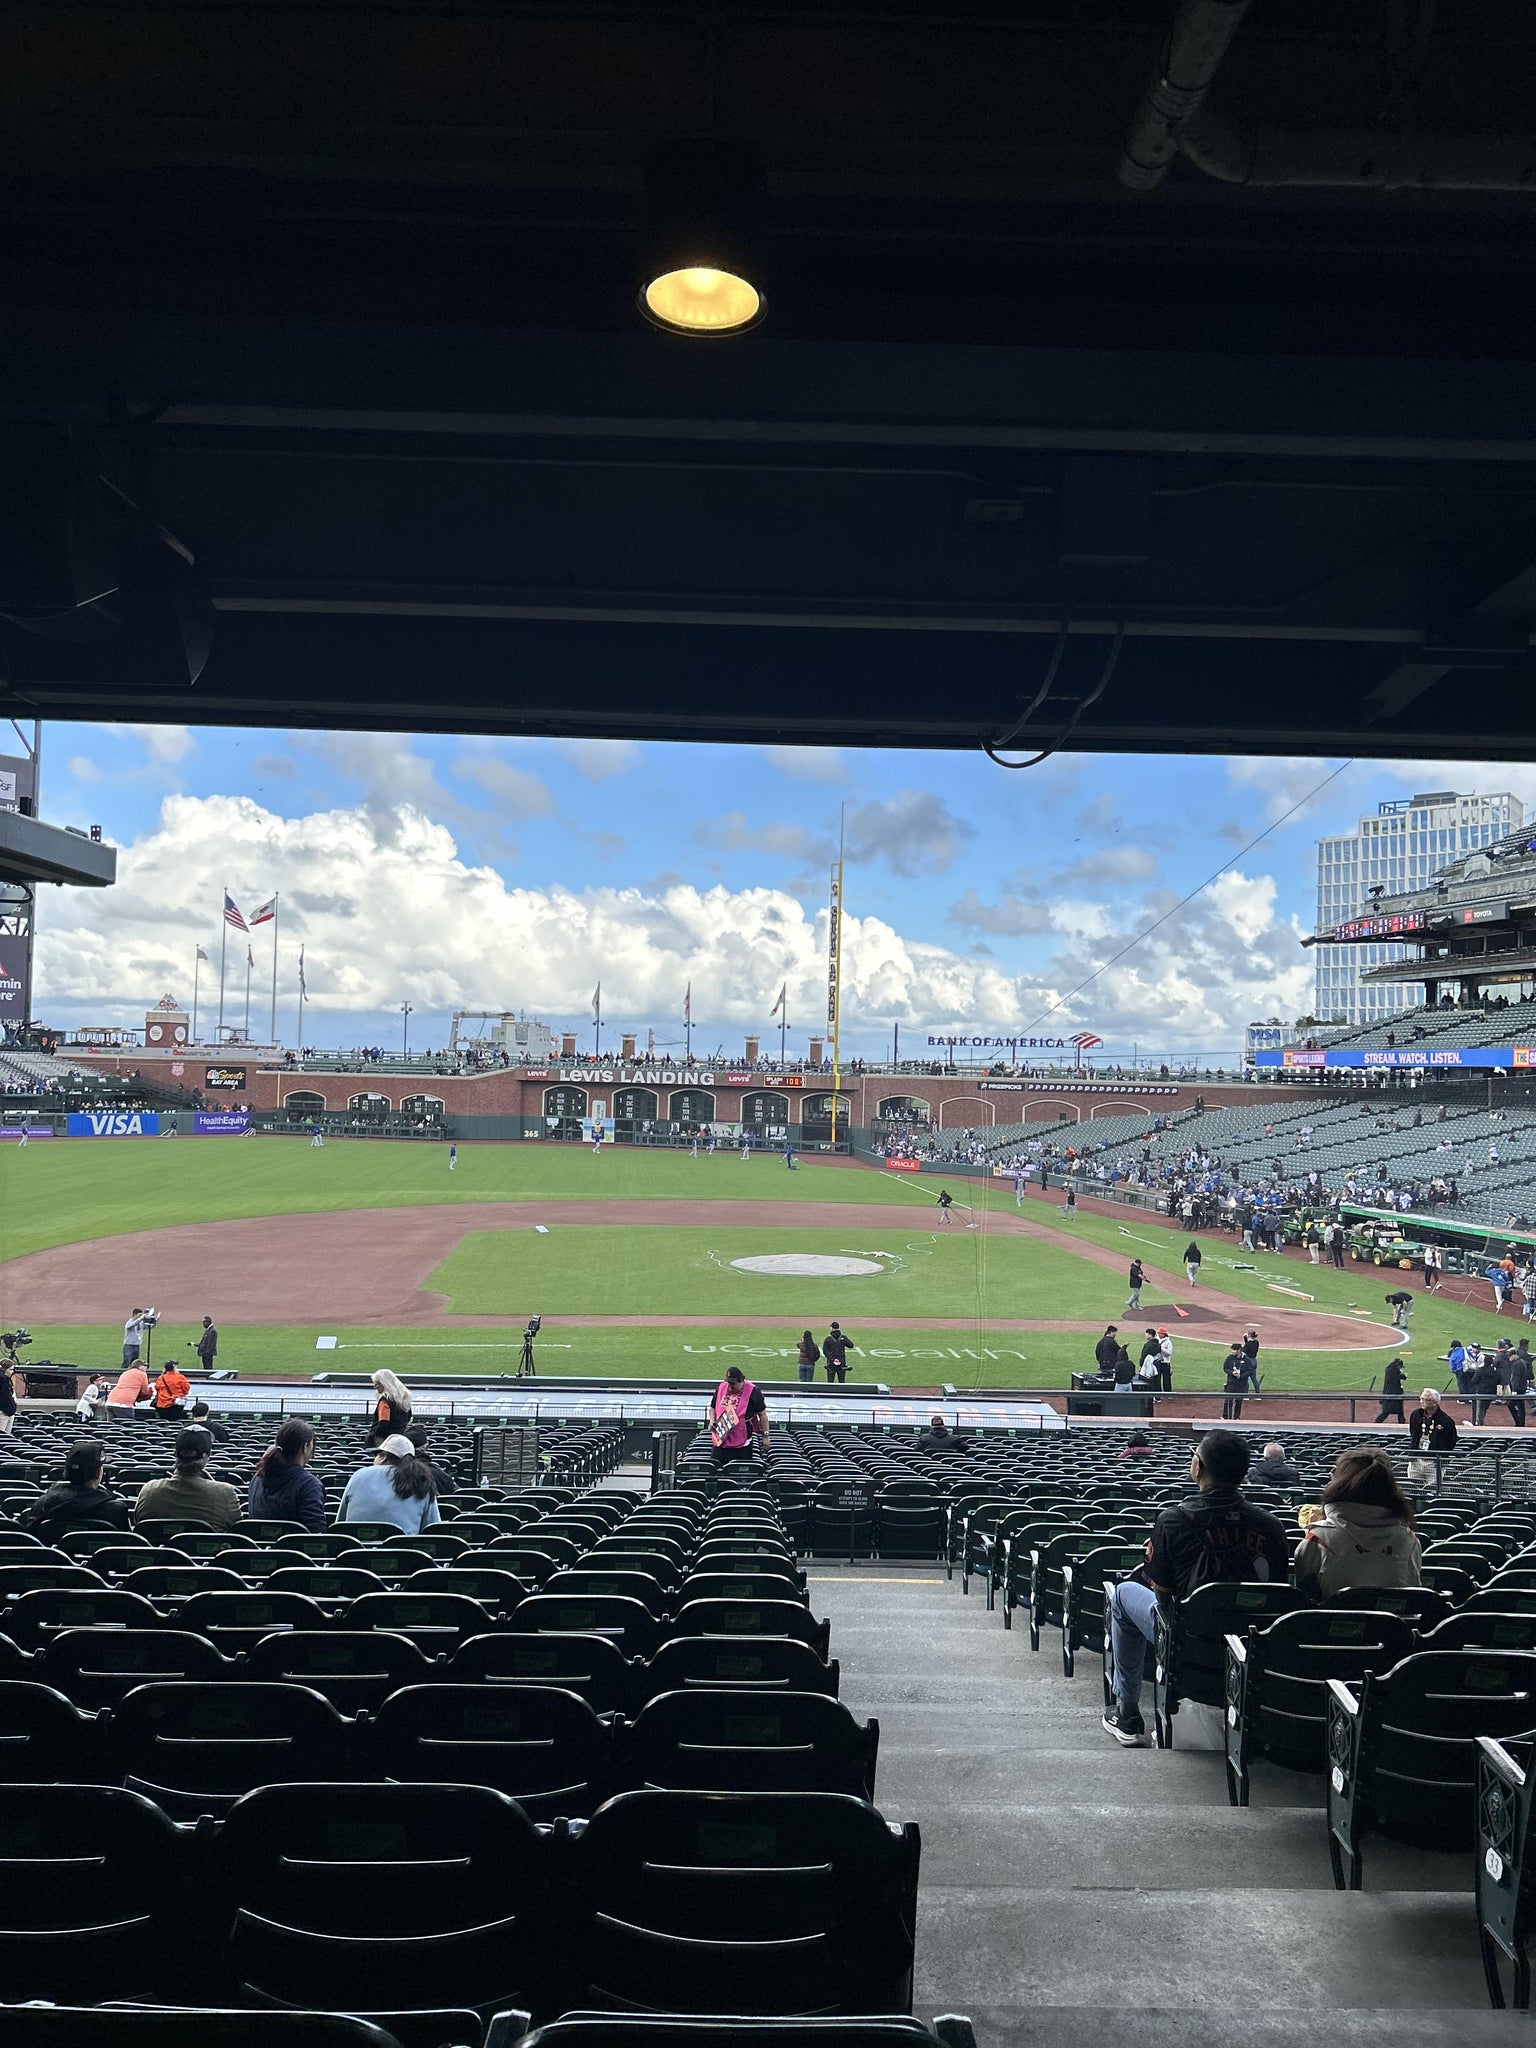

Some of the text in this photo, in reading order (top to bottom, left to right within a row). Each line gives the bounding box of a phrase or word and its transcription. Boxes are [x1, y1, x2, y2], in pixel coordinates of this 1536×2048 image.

[1473, 909, 1493, 919] TOYOTA
[1248, 1028, 1280, 1041] VISA
[927, 1036, 1065, 1047] BANK OF AMERICA
[1364, 1052, 1462, 1064] STREAM. WATCH. LISTEN.
[1515, 1052, 1527, 1064] THE
[218, 1069, 245, 1081] Sports
[620, 1071, 715, 1086] LANDING
[86, 1115, 143, 1135] VISA
[199, 1116, 249, 1126] HealthEquity
[523, 1130, 539, 1138] 365
[890, 1160, 915, 1168] ORACLE
[459, 1395, 551, 1412] SAN
[1488, 1852, 1500, 1874] 33
